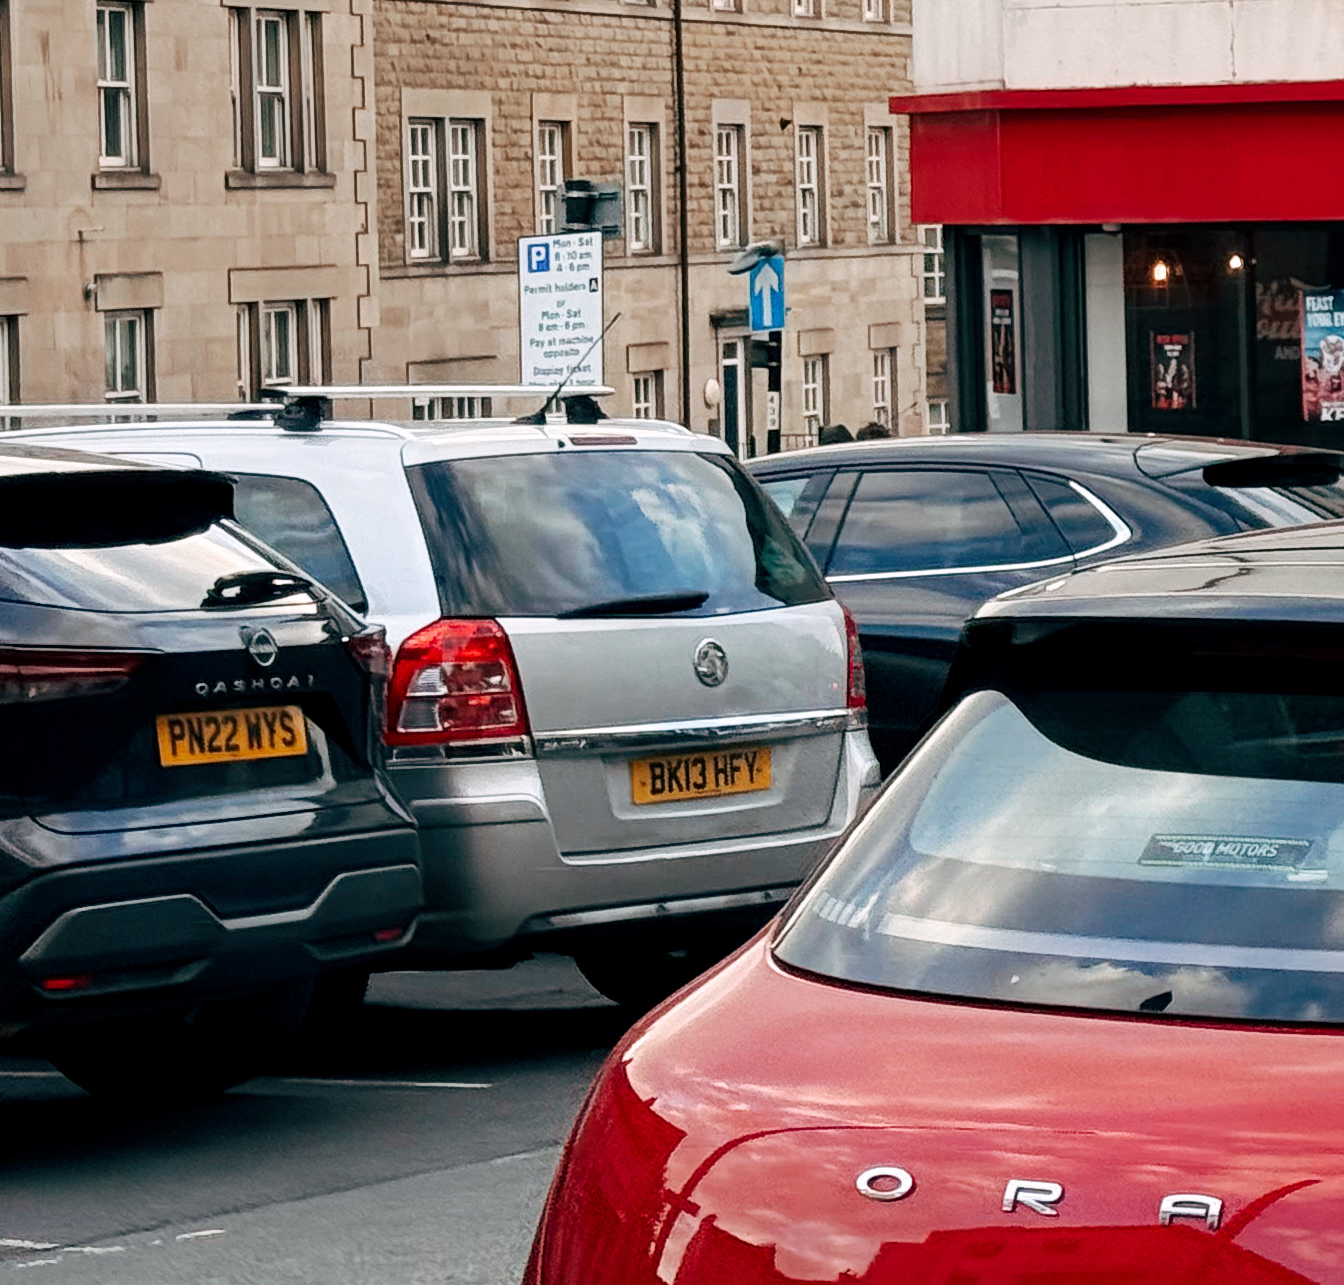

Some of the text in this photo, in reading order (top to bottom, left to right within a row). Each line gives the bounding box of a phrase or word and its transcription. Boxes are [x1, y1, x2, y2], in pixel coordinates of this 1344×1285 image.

[524, 284, 552, 295] Permit
[555, 280, 586, 292] holders
[1306, 296, 1334, 311] FEAST
[566, 309, 582, 318] Sat
[1306, 313, 1332, 327] YOUR
[530, 338, 545, 348] Pay
[548, 337, 556, 346] at
[196, 674, 314, 696] QASHQAI
[168, 710, 297, 757] PN22 WYS
[649, 750, 757, 795] BK13 HFY
[1215, 842, 1280, 858] MOTORS
